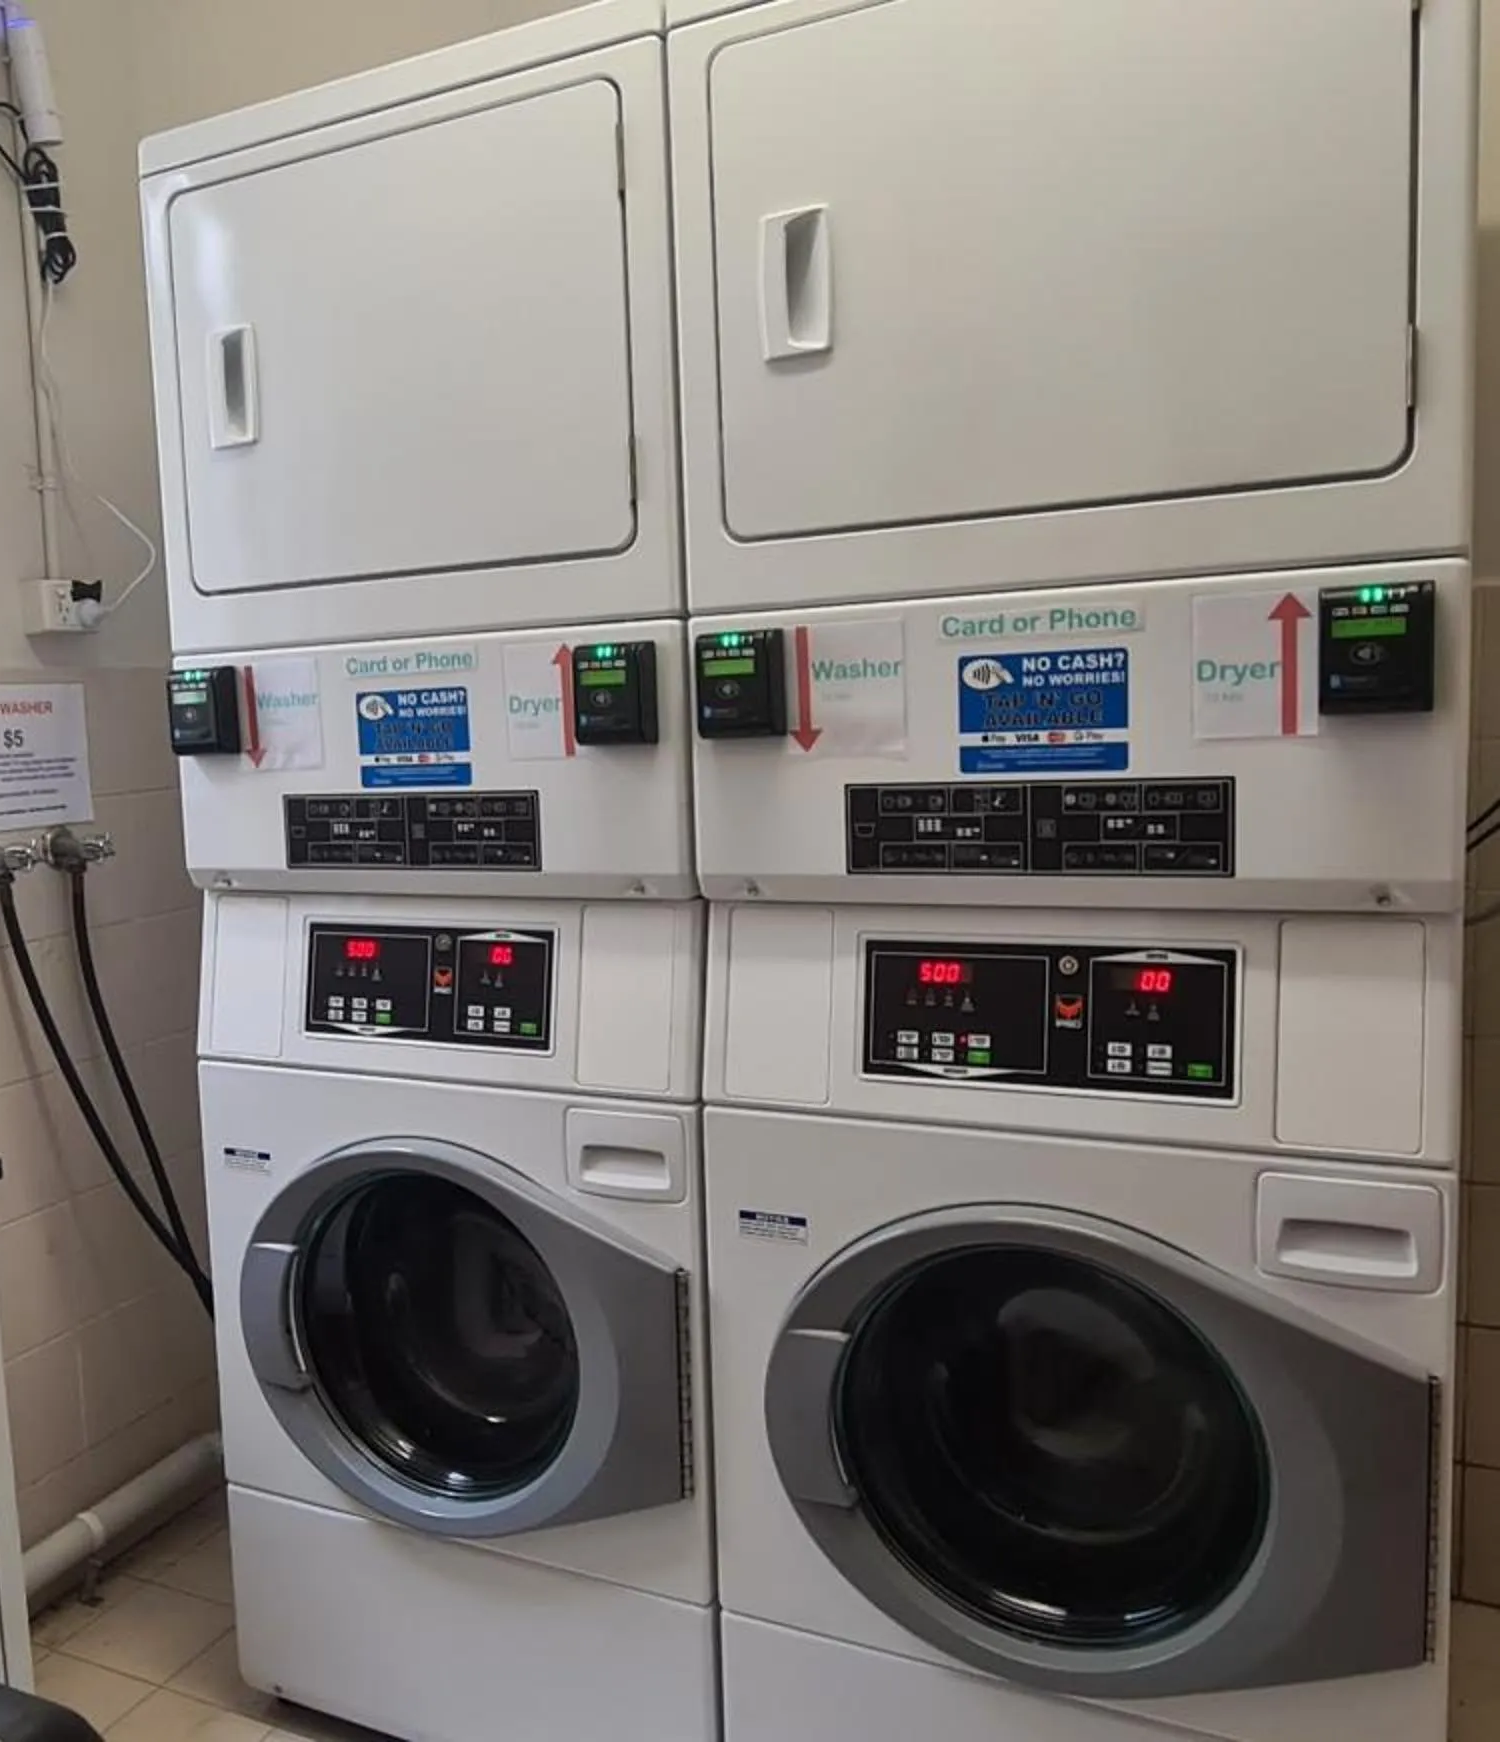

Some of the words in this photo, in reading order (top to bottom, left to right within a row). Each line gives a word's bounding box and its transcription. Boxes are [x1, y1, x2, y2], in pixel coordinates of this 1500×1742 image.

[942, 614, 1004, 637] Card
[1012, 615, 1041, 633] or
[1050, 608, 1136, 630] Phone
[346, 656, 388, 675] Card
[392, 656, 413, 672] or
[415, 651, 473, 670] Phone
[812, 657, 902, 681] Washer
[1022, 657, 1051, 673] NO
[1057, 652, 1126, 671] CASH?
[1197, 659, 1280, 686] Dryer
[1022, 674, 1046, 687] NO
[1049, 671, 1126, 686] WORRIES!
[0, 700, 54, 716] WASHER
[257, 689, 319, 709] Washer
[397, 693, 418, 706] NO
[420, 690, 466, 705] CASH?
[509, 695, 561, 716] Dryer
[397, 706, 415, 718] NO
[3, 728, 24, 749] $5
[347, 940, 377, 958] 500
[919, 962, 961, 983] 500
[1139, 970, 1172, 993] 00
